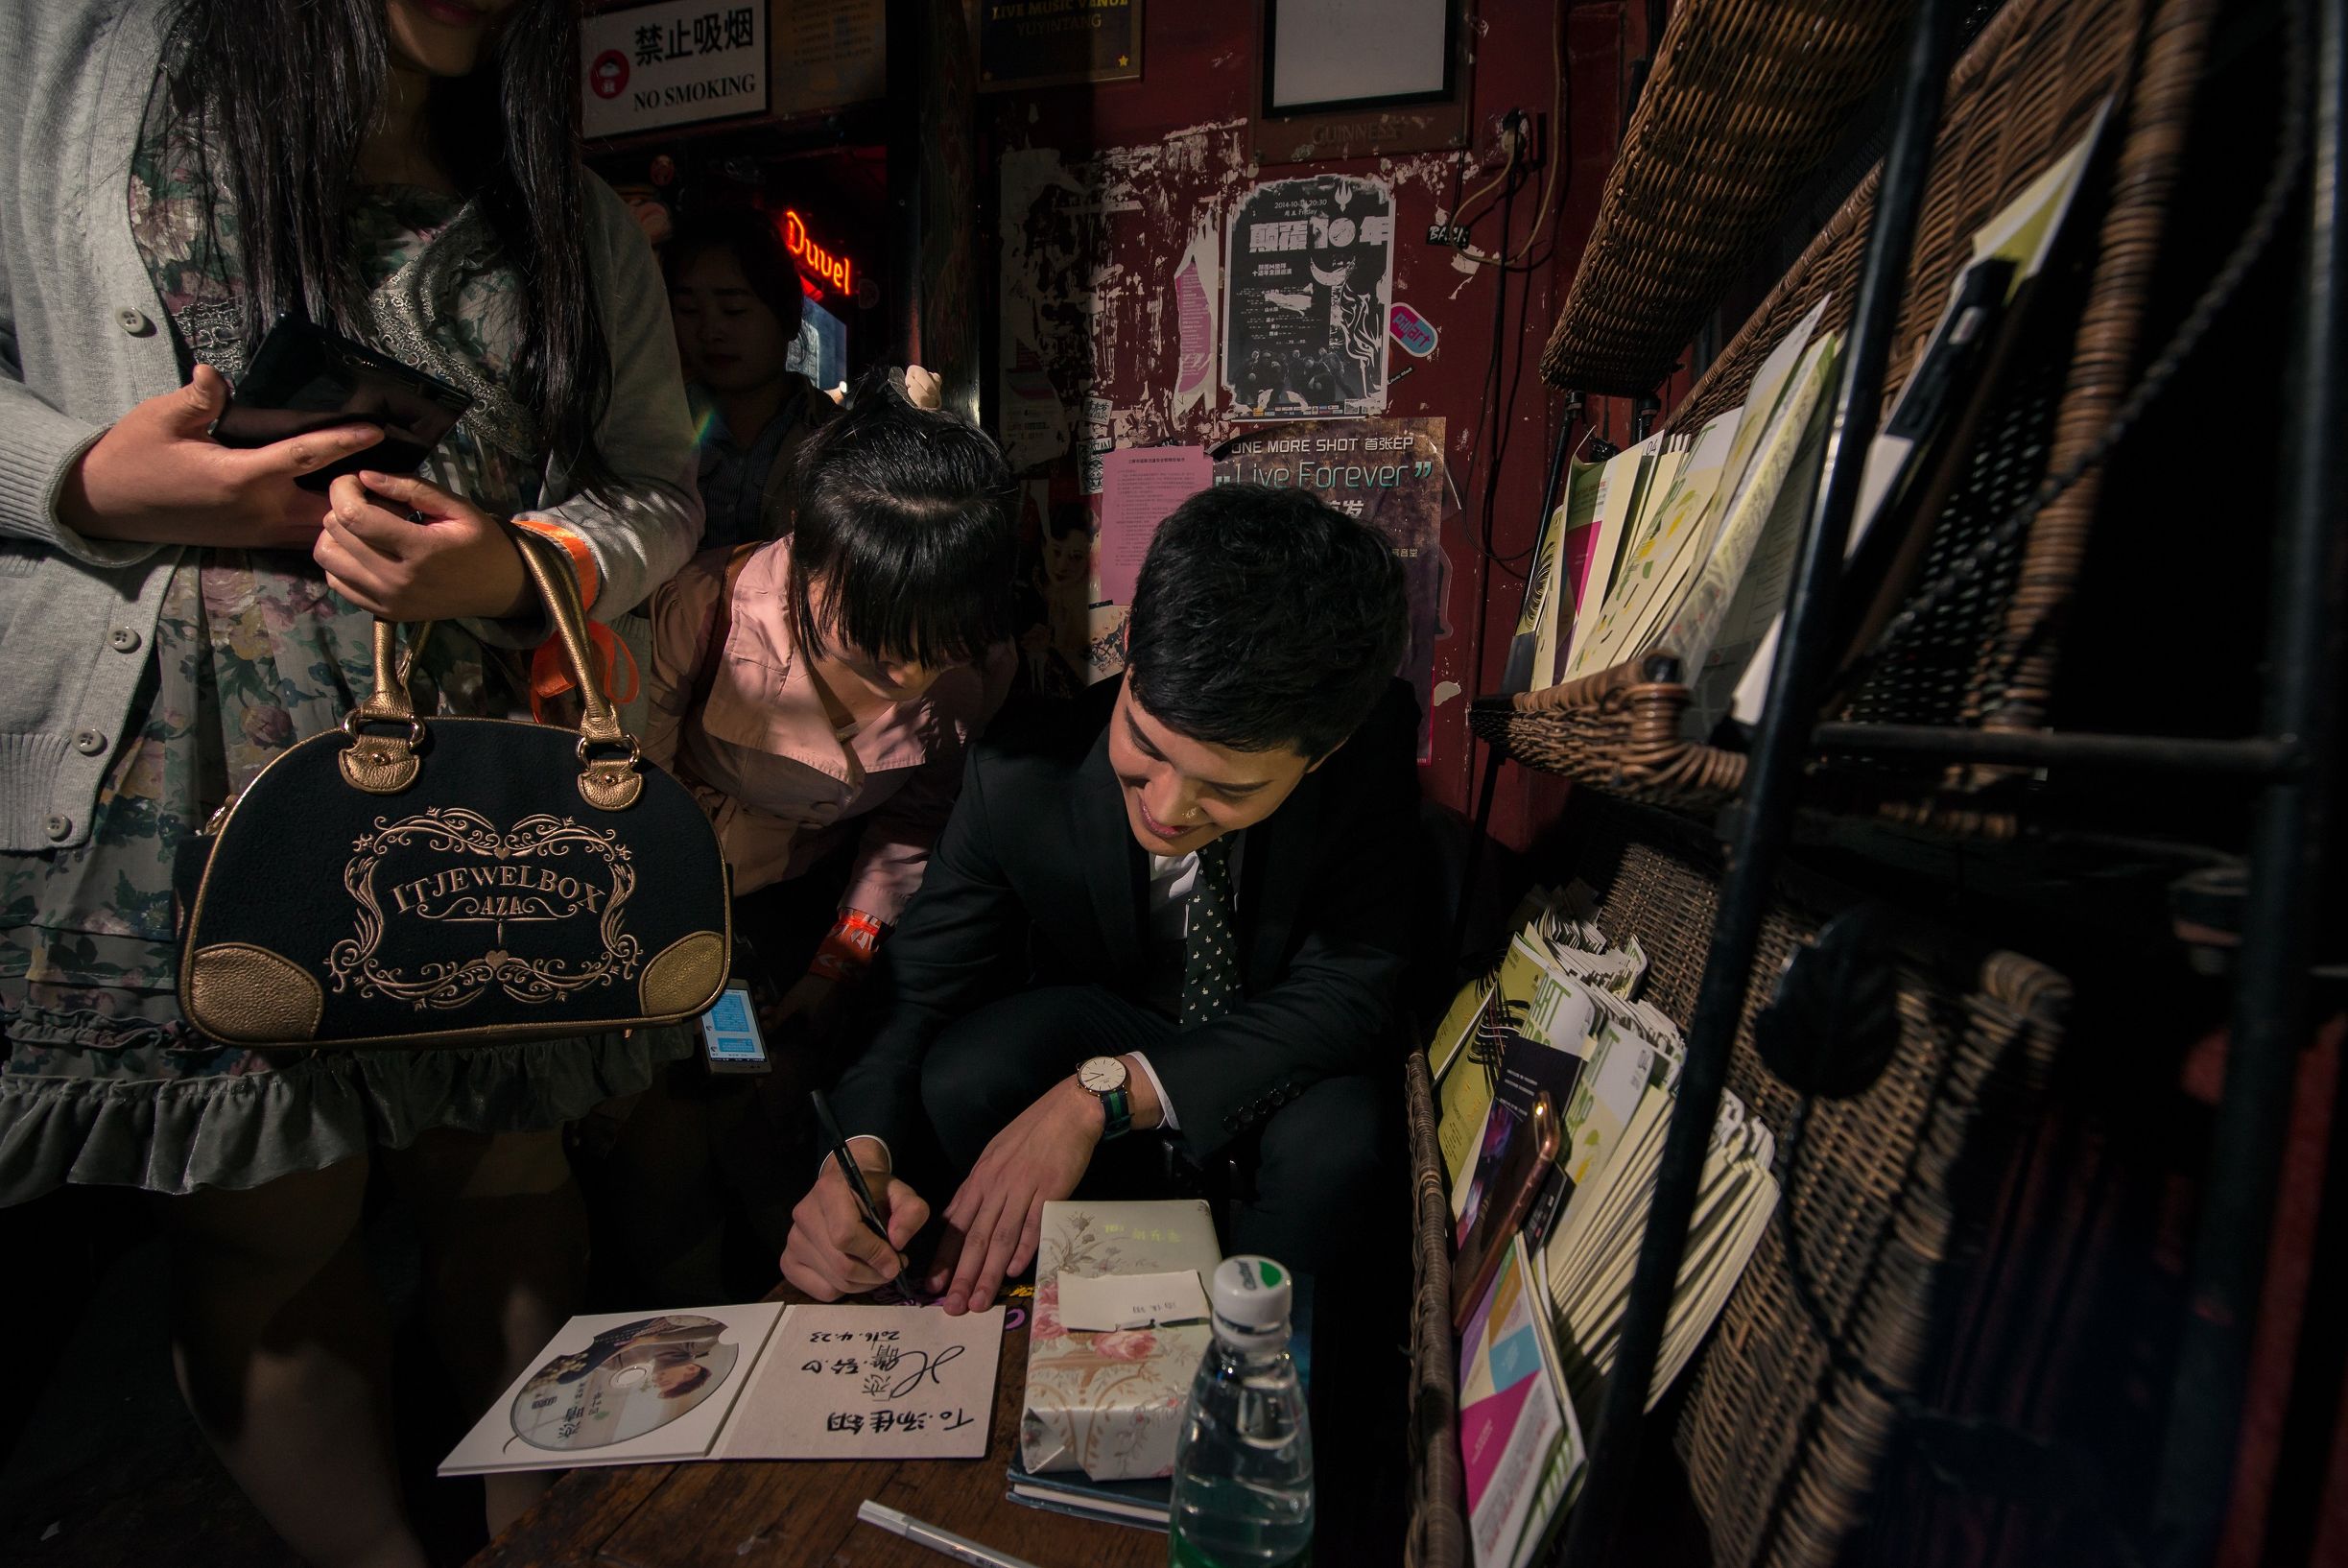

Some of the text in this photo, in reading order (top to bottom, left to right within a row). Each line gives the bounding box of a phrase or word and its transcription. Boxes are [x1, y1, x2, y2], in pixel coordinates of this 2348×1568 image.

[992, 4, 1026, 20] LIVE
[1029, 0, 1075, 16] MUSIC
[1017, 13, 1103, 36] YUYINTANG
[635, 7, 753, 66] 禁止吸烟
[633, 74, 756, 111] NO SMOKING
[1312, 121, 1398, 144] GUINNESS
[786, 210, 850, 296] Duvel
[1231, 440, 1263, 455] ONE
[1268, 440, 1311, 453] MORE
[1316, 438, 1359, 452] SHOT
[391, 865, 605, 915] ITJEWELBOX
[480, 895, 524, 916] AZA
